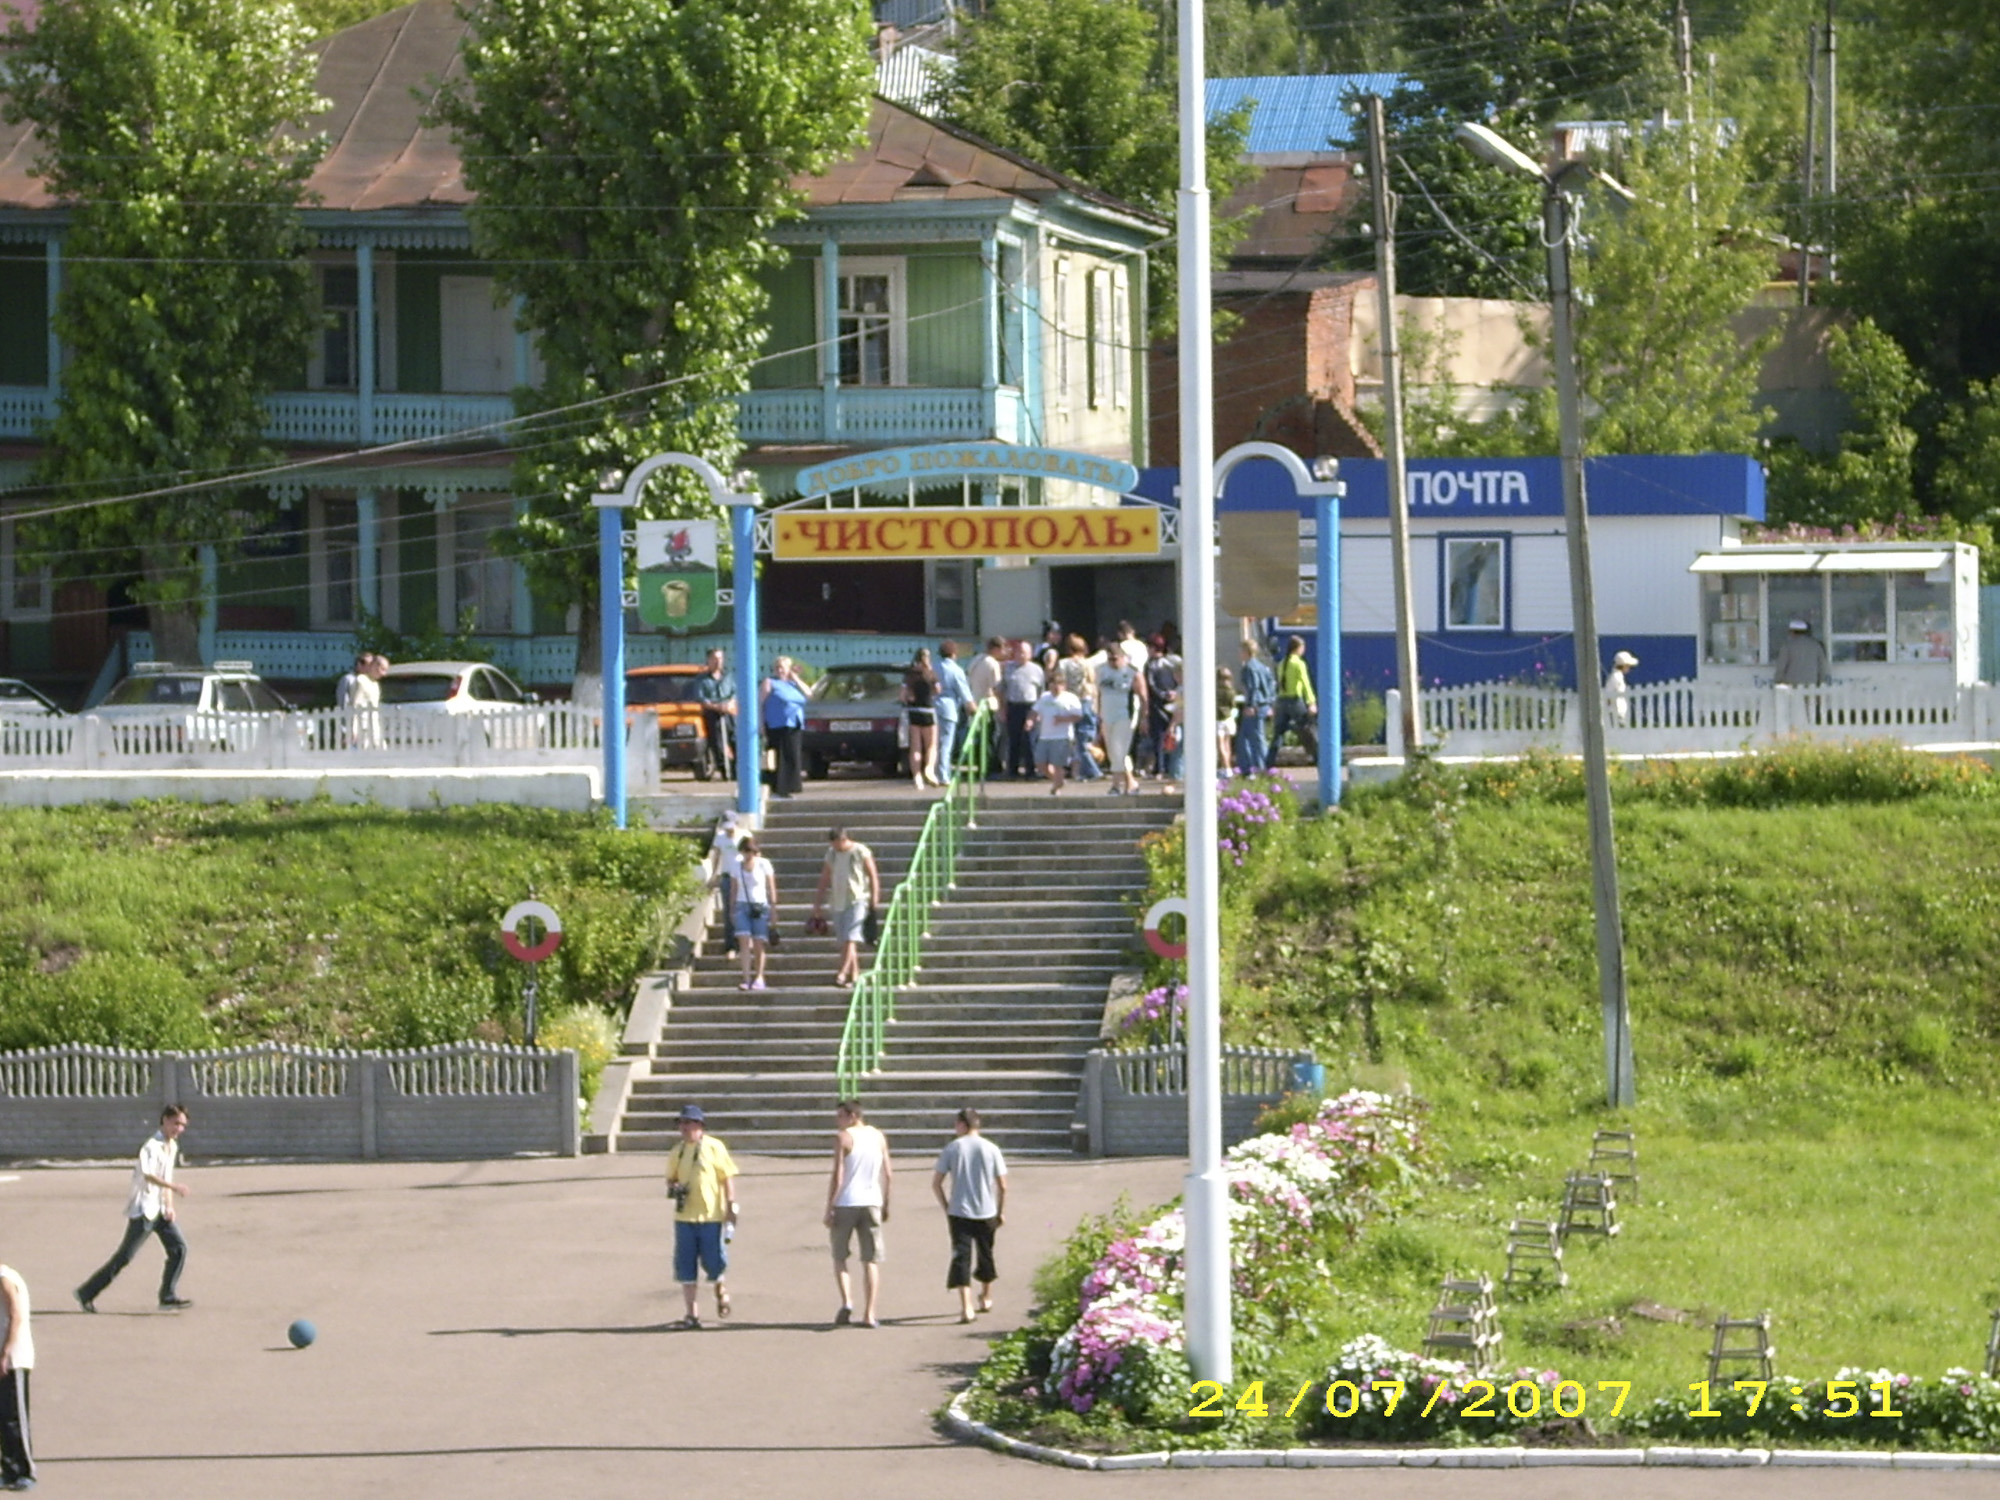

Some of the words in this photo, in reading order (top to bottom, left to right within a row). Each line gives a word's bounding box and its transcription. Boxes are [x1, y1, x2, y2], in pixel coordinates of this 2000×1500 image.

[807, 455, 900, 492] ДОБРО
[910, 451, 1126, 486] ПОЖАЛОВАТЬ!
[1407, 470, 1529, 505] ПОЧТА
[796, 515, 1132, 551] ЧИСТОПОЛЬ
